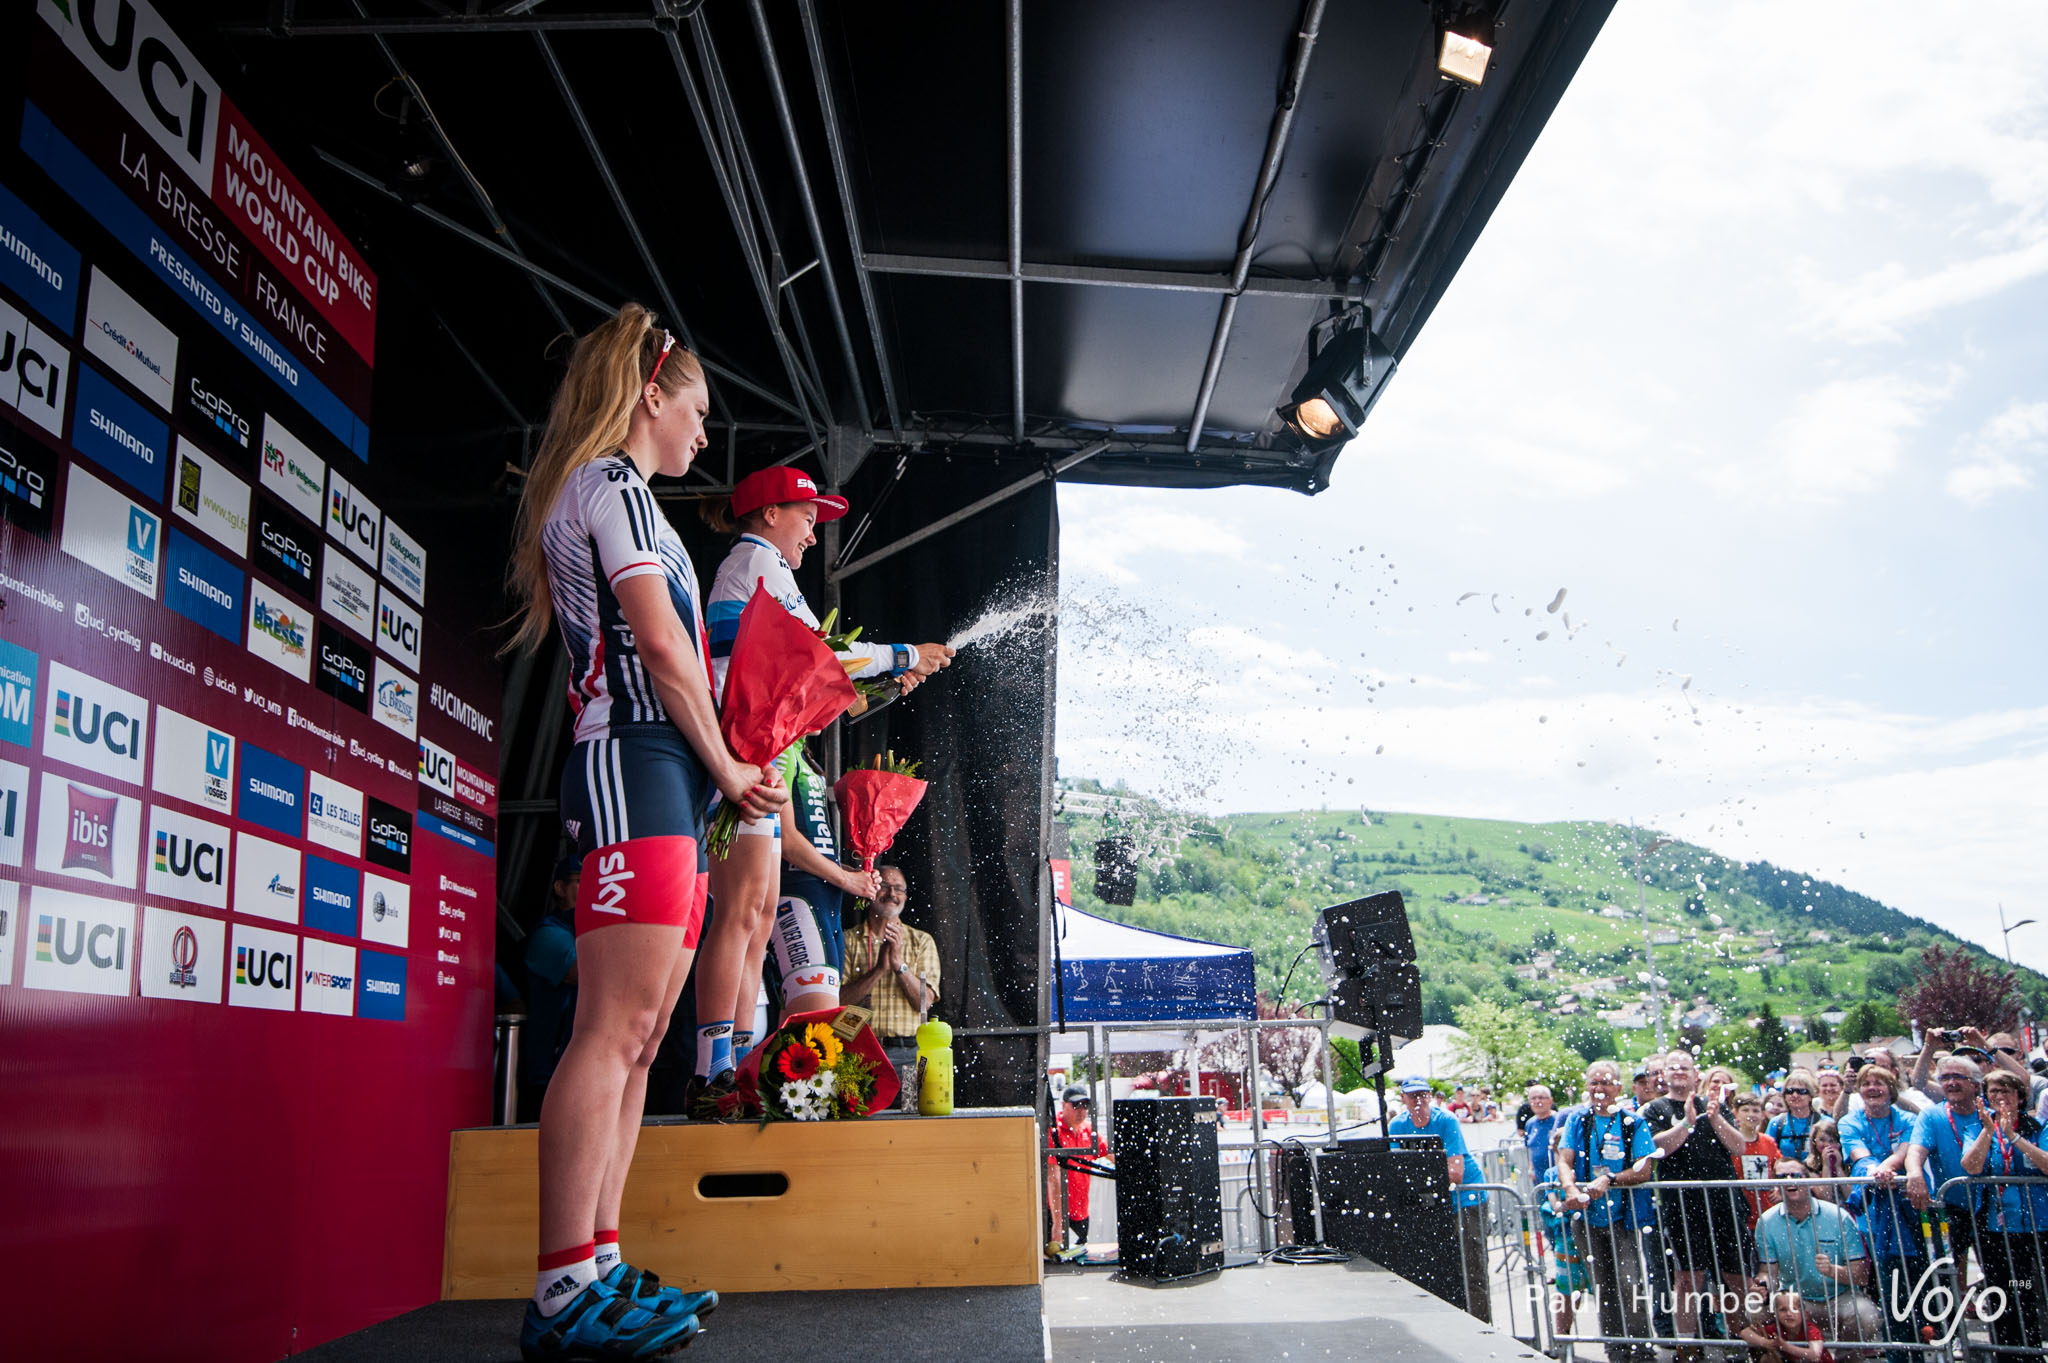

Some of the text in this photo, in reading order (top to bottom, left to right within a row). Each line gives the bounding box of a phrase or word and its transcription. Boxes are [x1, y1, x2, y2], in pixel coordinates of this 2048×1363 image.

[225, 162, 339, 306] WORLD CUP
[228, 123, 373, 311] MOUNTAIN BIKE
[120, 132, 327, 364] LA BRESSE FRANCE
[150, 237, 298, 386] PRESENTED BY SHIMANO
[103, 322, 127, 348] Crédit
[135, 348, 161, 374] Mutuel
[191, 377, 250, 434] GoPro
[90, 408, 154, 465] SHIMANO
[341, 496, 376, 551] UCI
[261, 521, 312, 567] GoPro
[389, 532, 421, 568] Bikepark
[178, 566, 233, 610] SHIMANO
[255, 596, 267, 614] LA
[90, 616, 141, 652] uci_cycling
[254, 608, 305, 650] BRESSE
[388, 610, 418, 656] UCI
[162, 649, 196, 676] tv.uci.ch
[322, 645, 365, 681] GoPro
[216, 677, 237, 696] uci.ch
[253, 693, 282, 717] UCI_MTB
[72, 695, 140, 761] UCI
[296, 714, 307, 729] UCI
[430, 683, 493, 742] #UCIMTBWC
[425, 748, 453, 789] UCI
[456, 765, 484, 790] MOUNTAIN
[204, 784, 227, 801] VOSGES
[249, 777, 295, 807] SHIMANO
[456, 781, 487, 806] WORLD CUP
[72, 809, 108, 848] ibis
[326, 803, 361, 828] LES ZELLES
[370, 818, 408, 844] GoPro
[434, 796, 484, 831] LA BRESSE FRANCE
[169, 834, 223, 885] UCI
[313, 886, 351, 909] SHIMANO
[591, 851, 635, 916] sky
[55, 917, 126, 970] UCI
[779, 914, 809, 968] VAN DER HEIDE
[248, 948, 292, 990] UCI
[313, 970, 352, 990] INTERSPORT
[366, 978, 400, 996] SHIMANO
